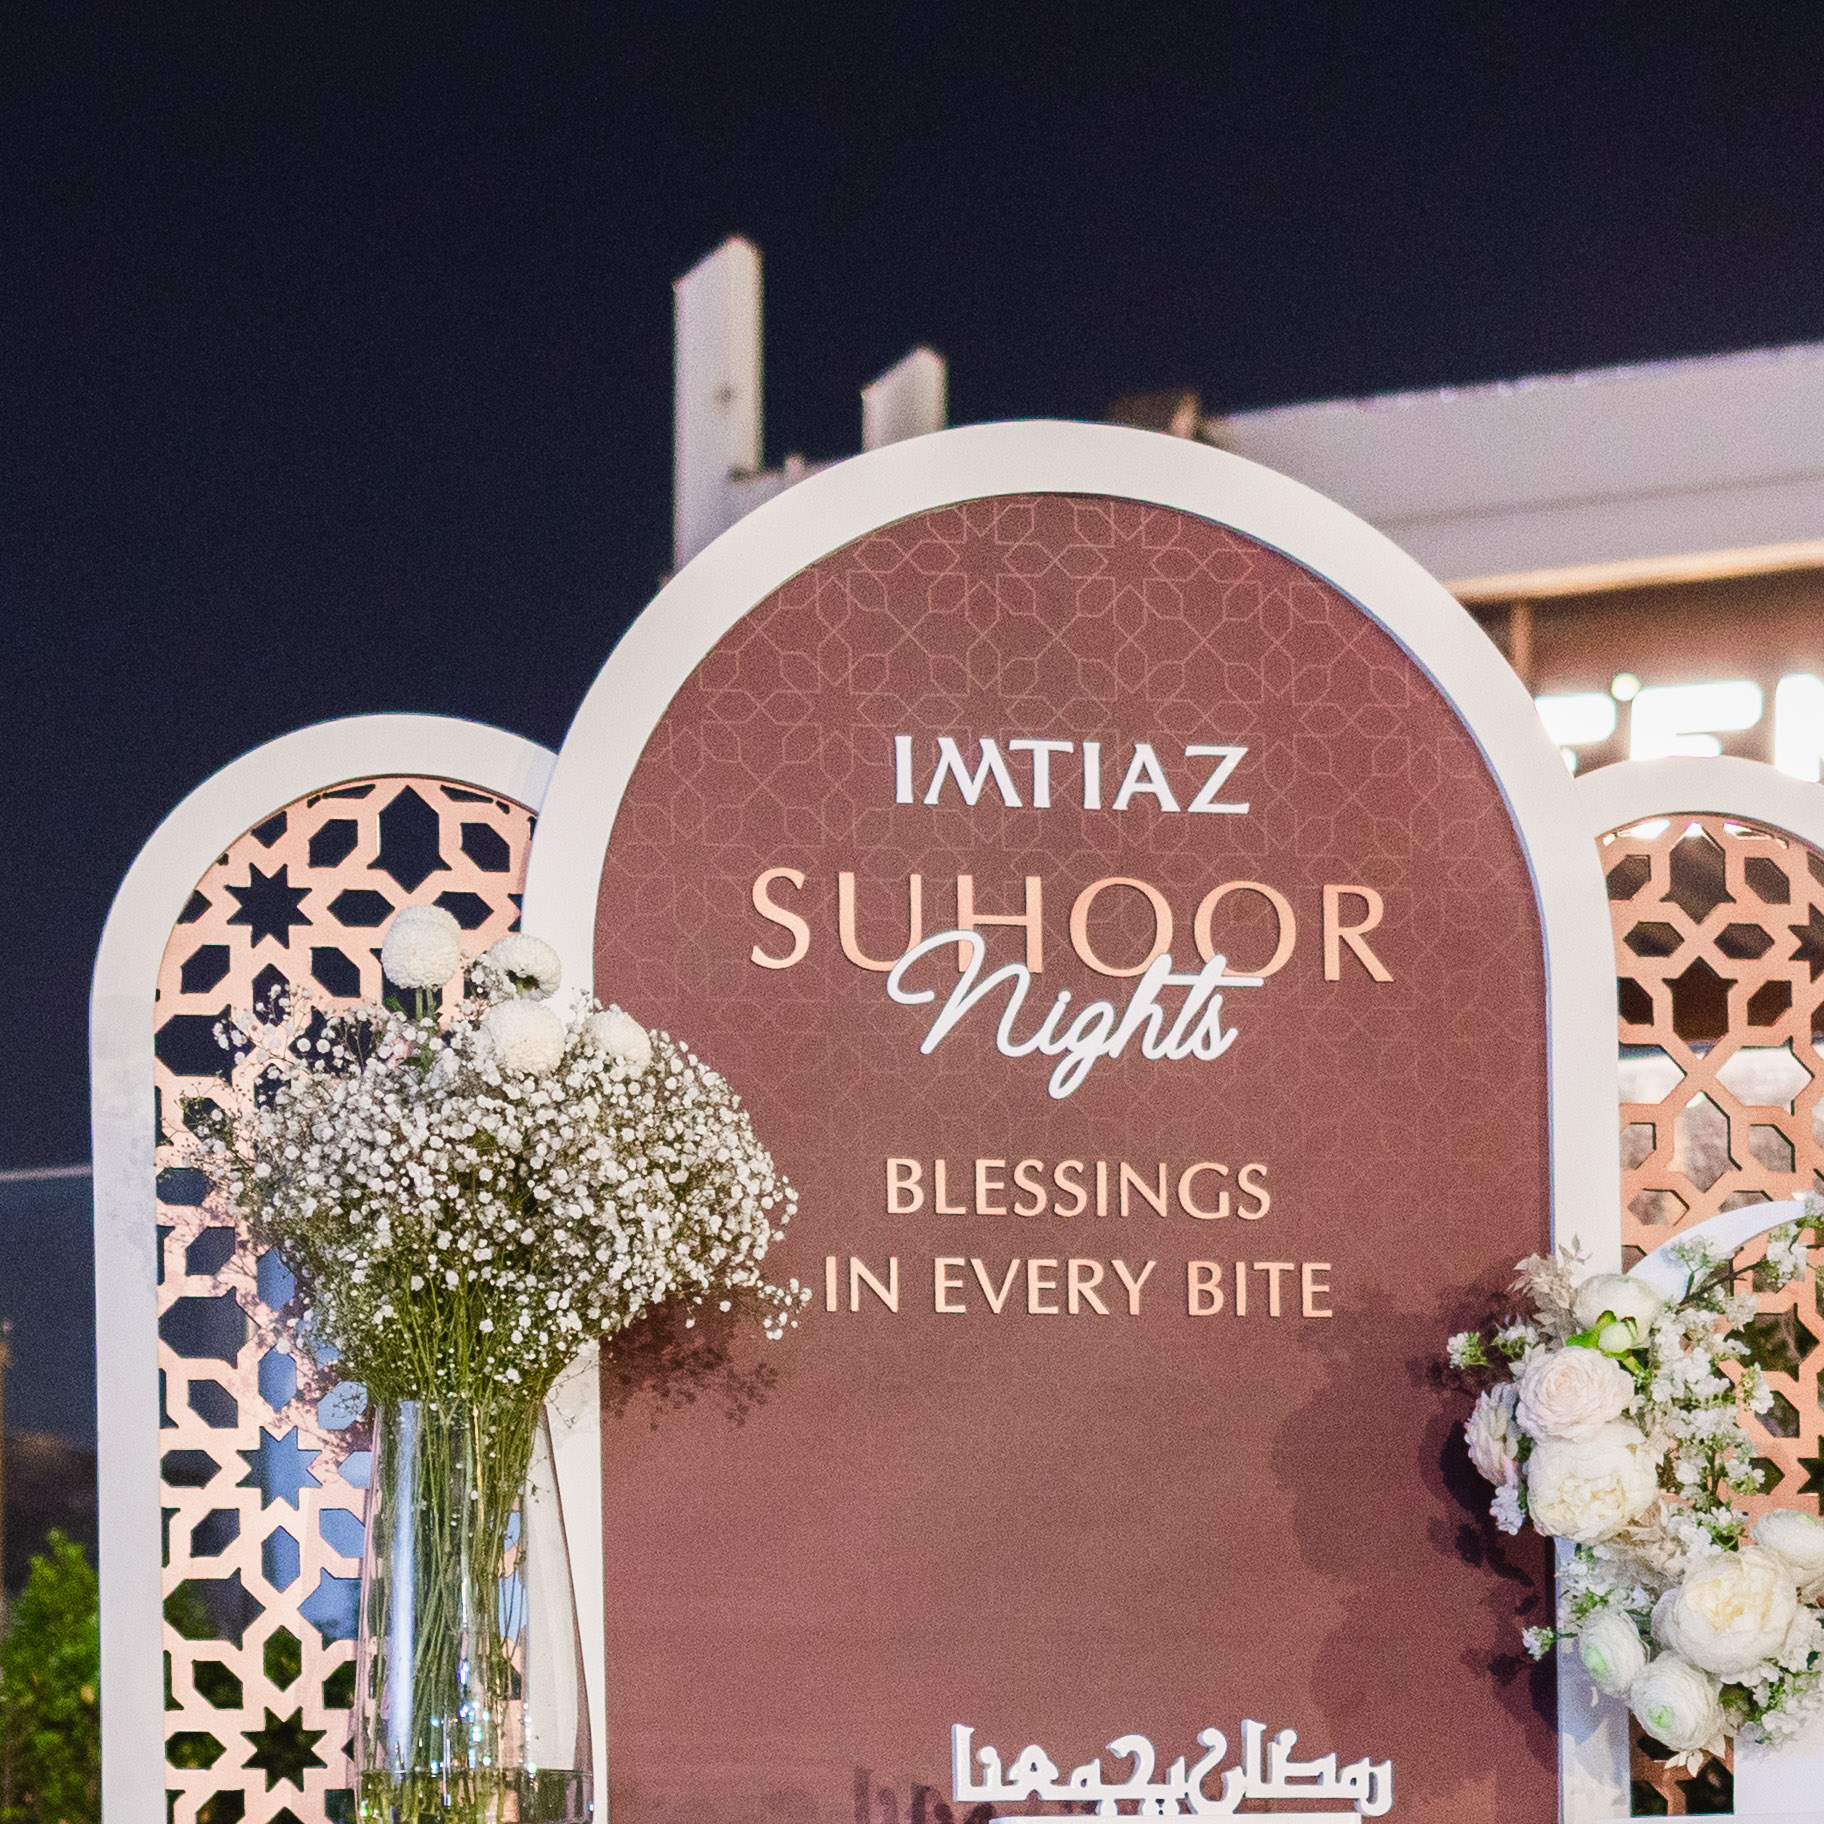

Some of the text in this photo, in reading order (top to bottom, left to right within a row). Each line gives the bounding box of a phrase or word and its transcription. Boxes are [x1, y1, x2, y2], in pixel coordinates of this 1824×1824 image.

[895, 736, 1249, 814] IMTIAZ
[750, 867, 1394, 983] SUHOOR
[887, 930, 1264, 1098] Nights
[885, 1158, 1271, 1220] BLESSINGS
[824, 1256, 1334, 1318] IN EVERY BITE
[951, 1719, 1392, 1816] رمضان يجمعنا
